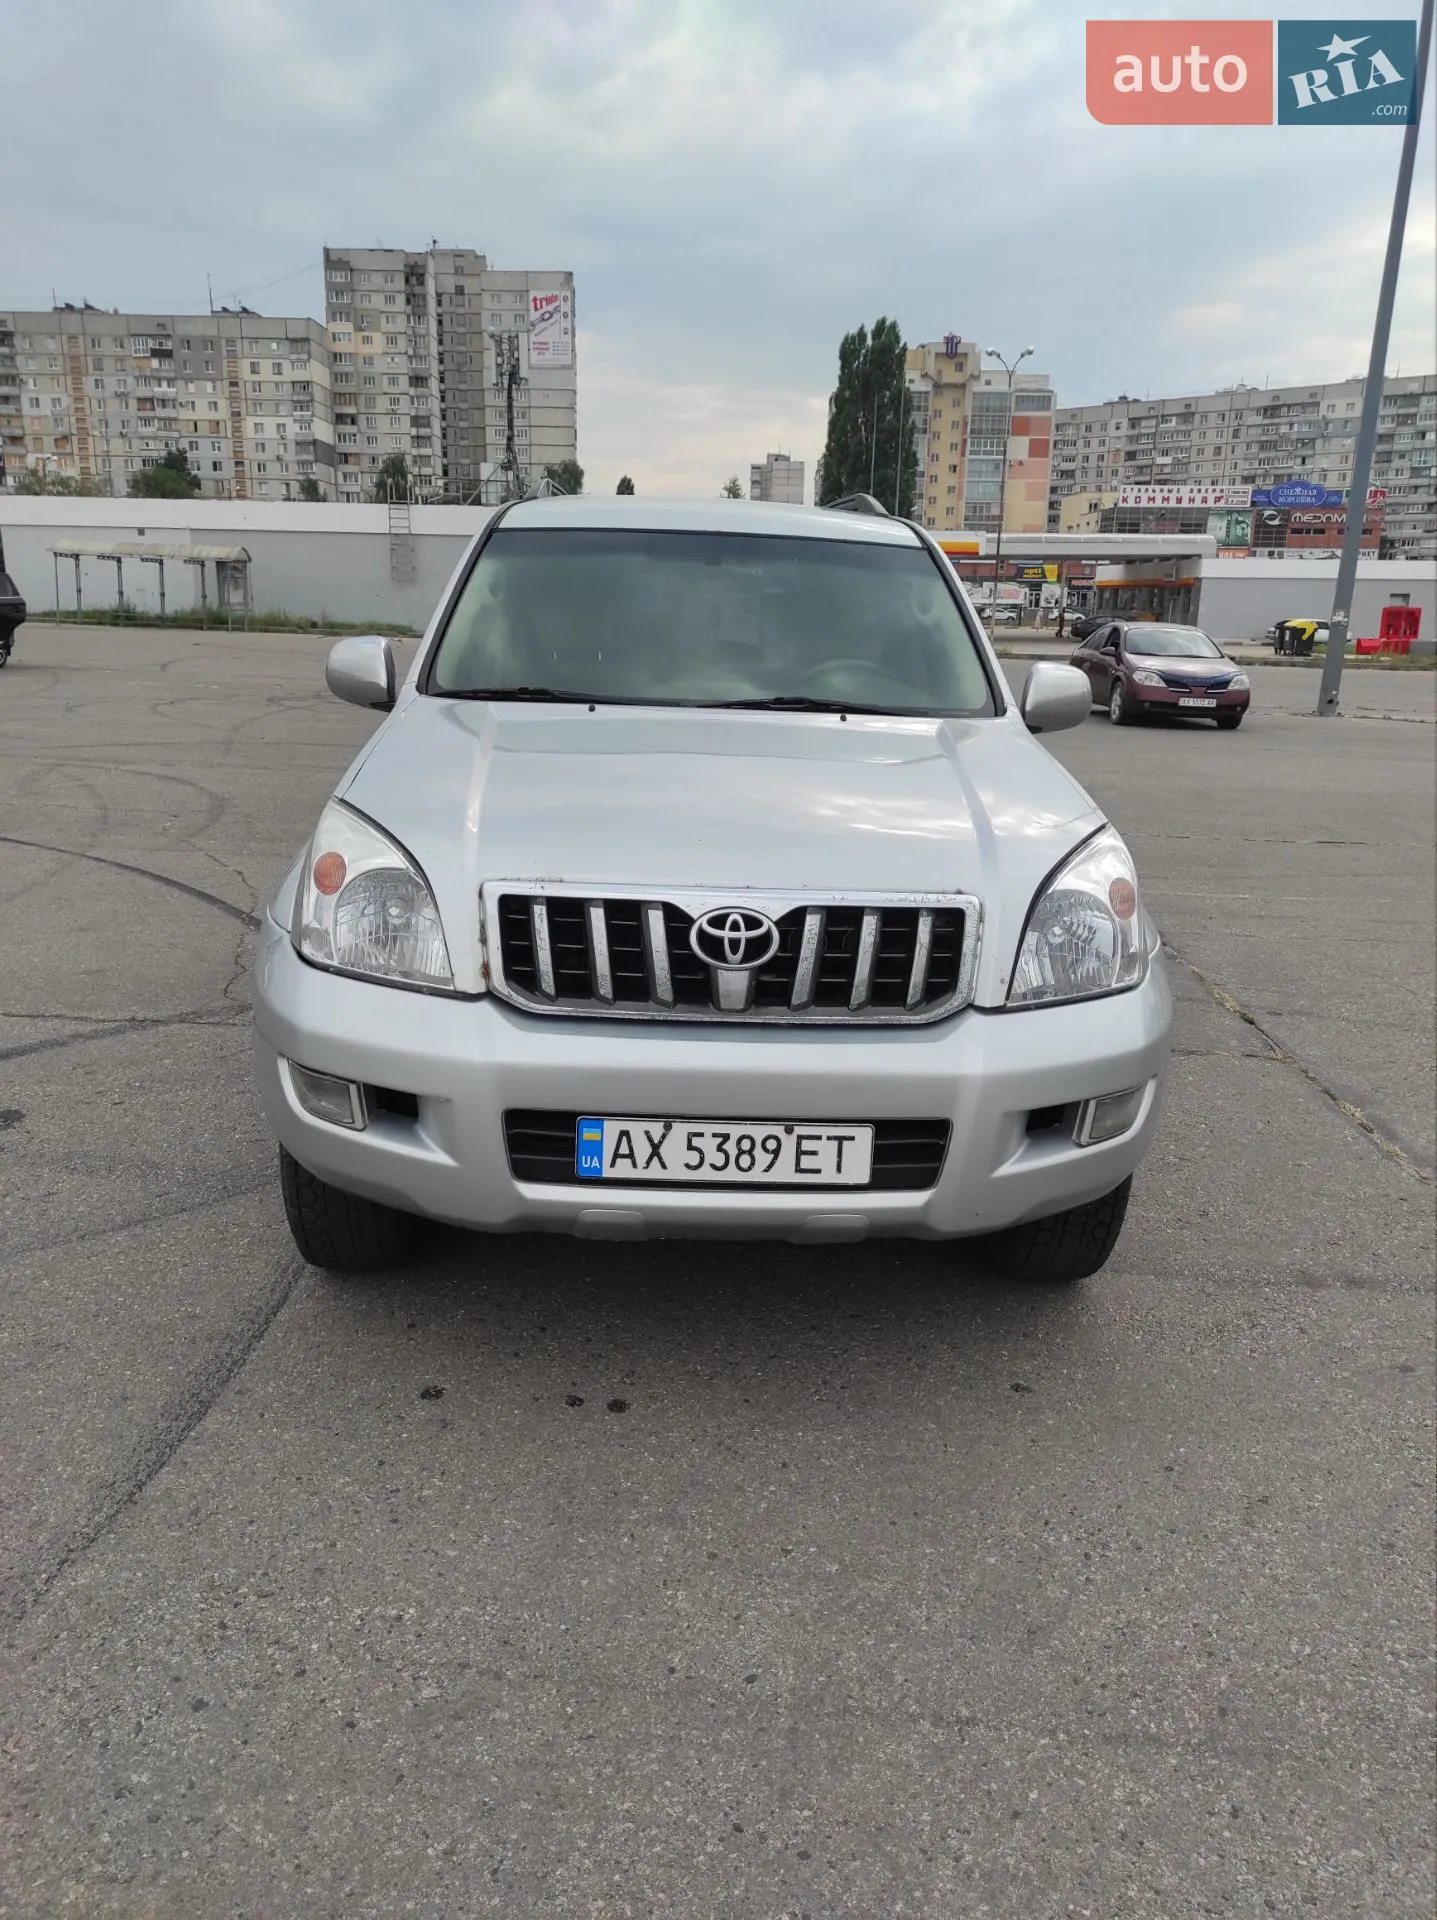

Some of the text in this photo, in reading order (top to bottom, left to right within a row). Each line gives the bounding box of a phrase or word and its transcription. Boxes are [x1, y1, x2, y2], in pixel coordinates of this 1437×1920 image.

[1279, 487, 1317, 496] СНЕЖНАЯ
[1121, 495, 1222, 505] КОММУНАР
[609, 1129, 856, 1175] AX 5389 ET
[582, 1155, 600, 1168] UA
